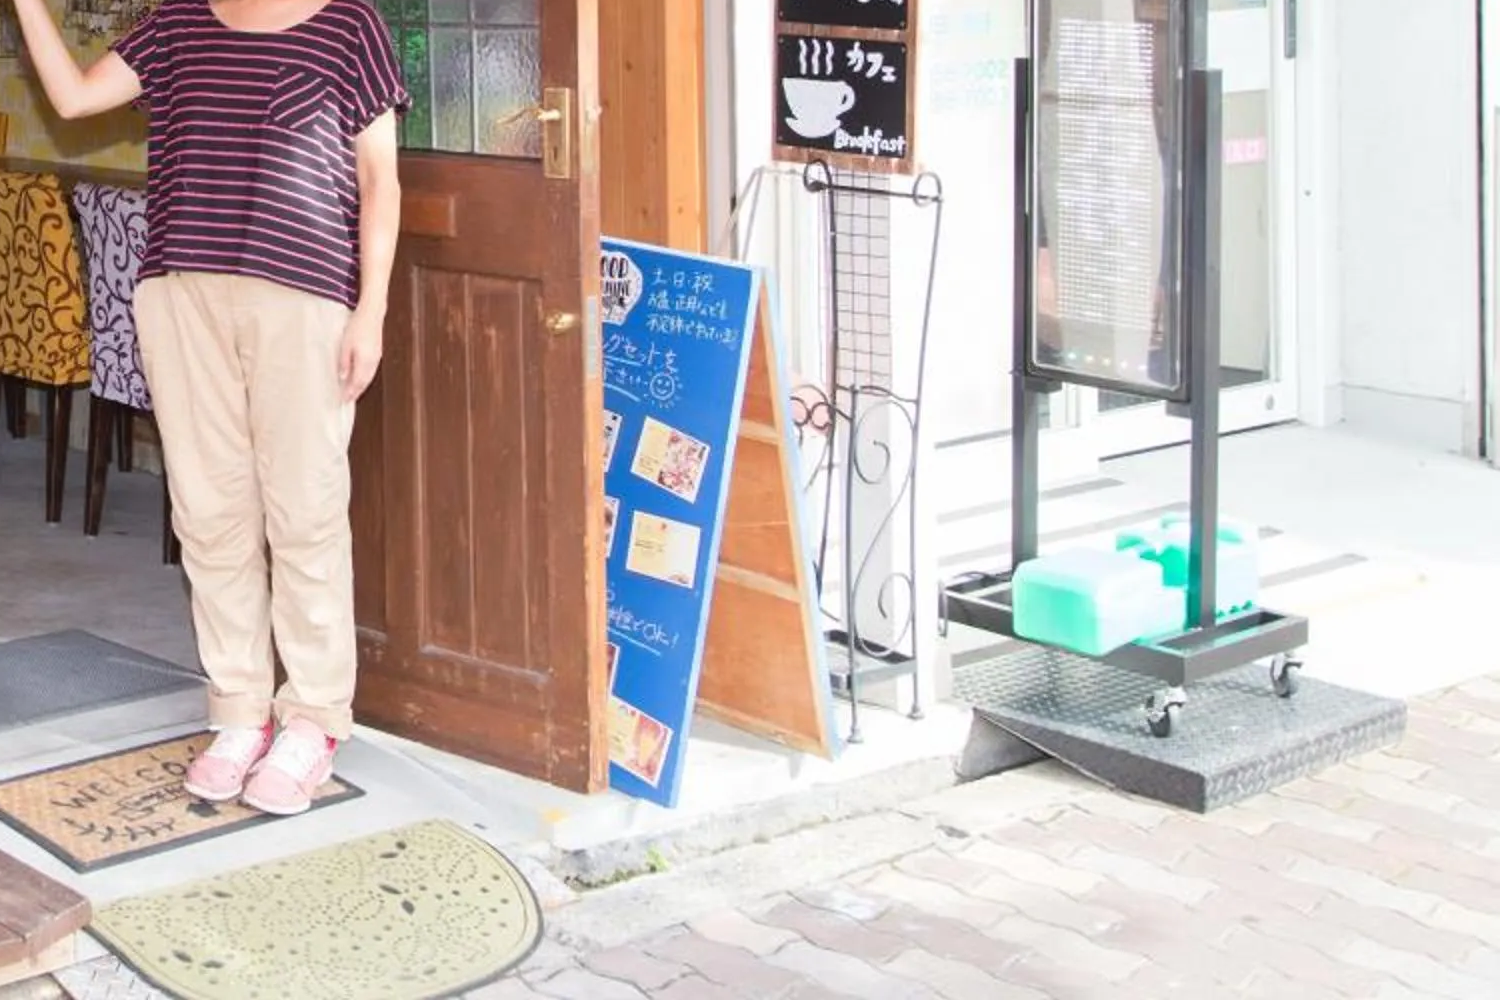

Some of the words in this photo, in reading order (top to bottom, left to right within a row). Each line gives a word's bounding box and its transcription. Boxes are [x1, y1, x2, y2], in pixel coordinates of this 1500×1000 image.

[846, 41, 897, 83] カフェ
[600, 256, 629, 279] OOD
[52, 754, 192, 809] WELCO
